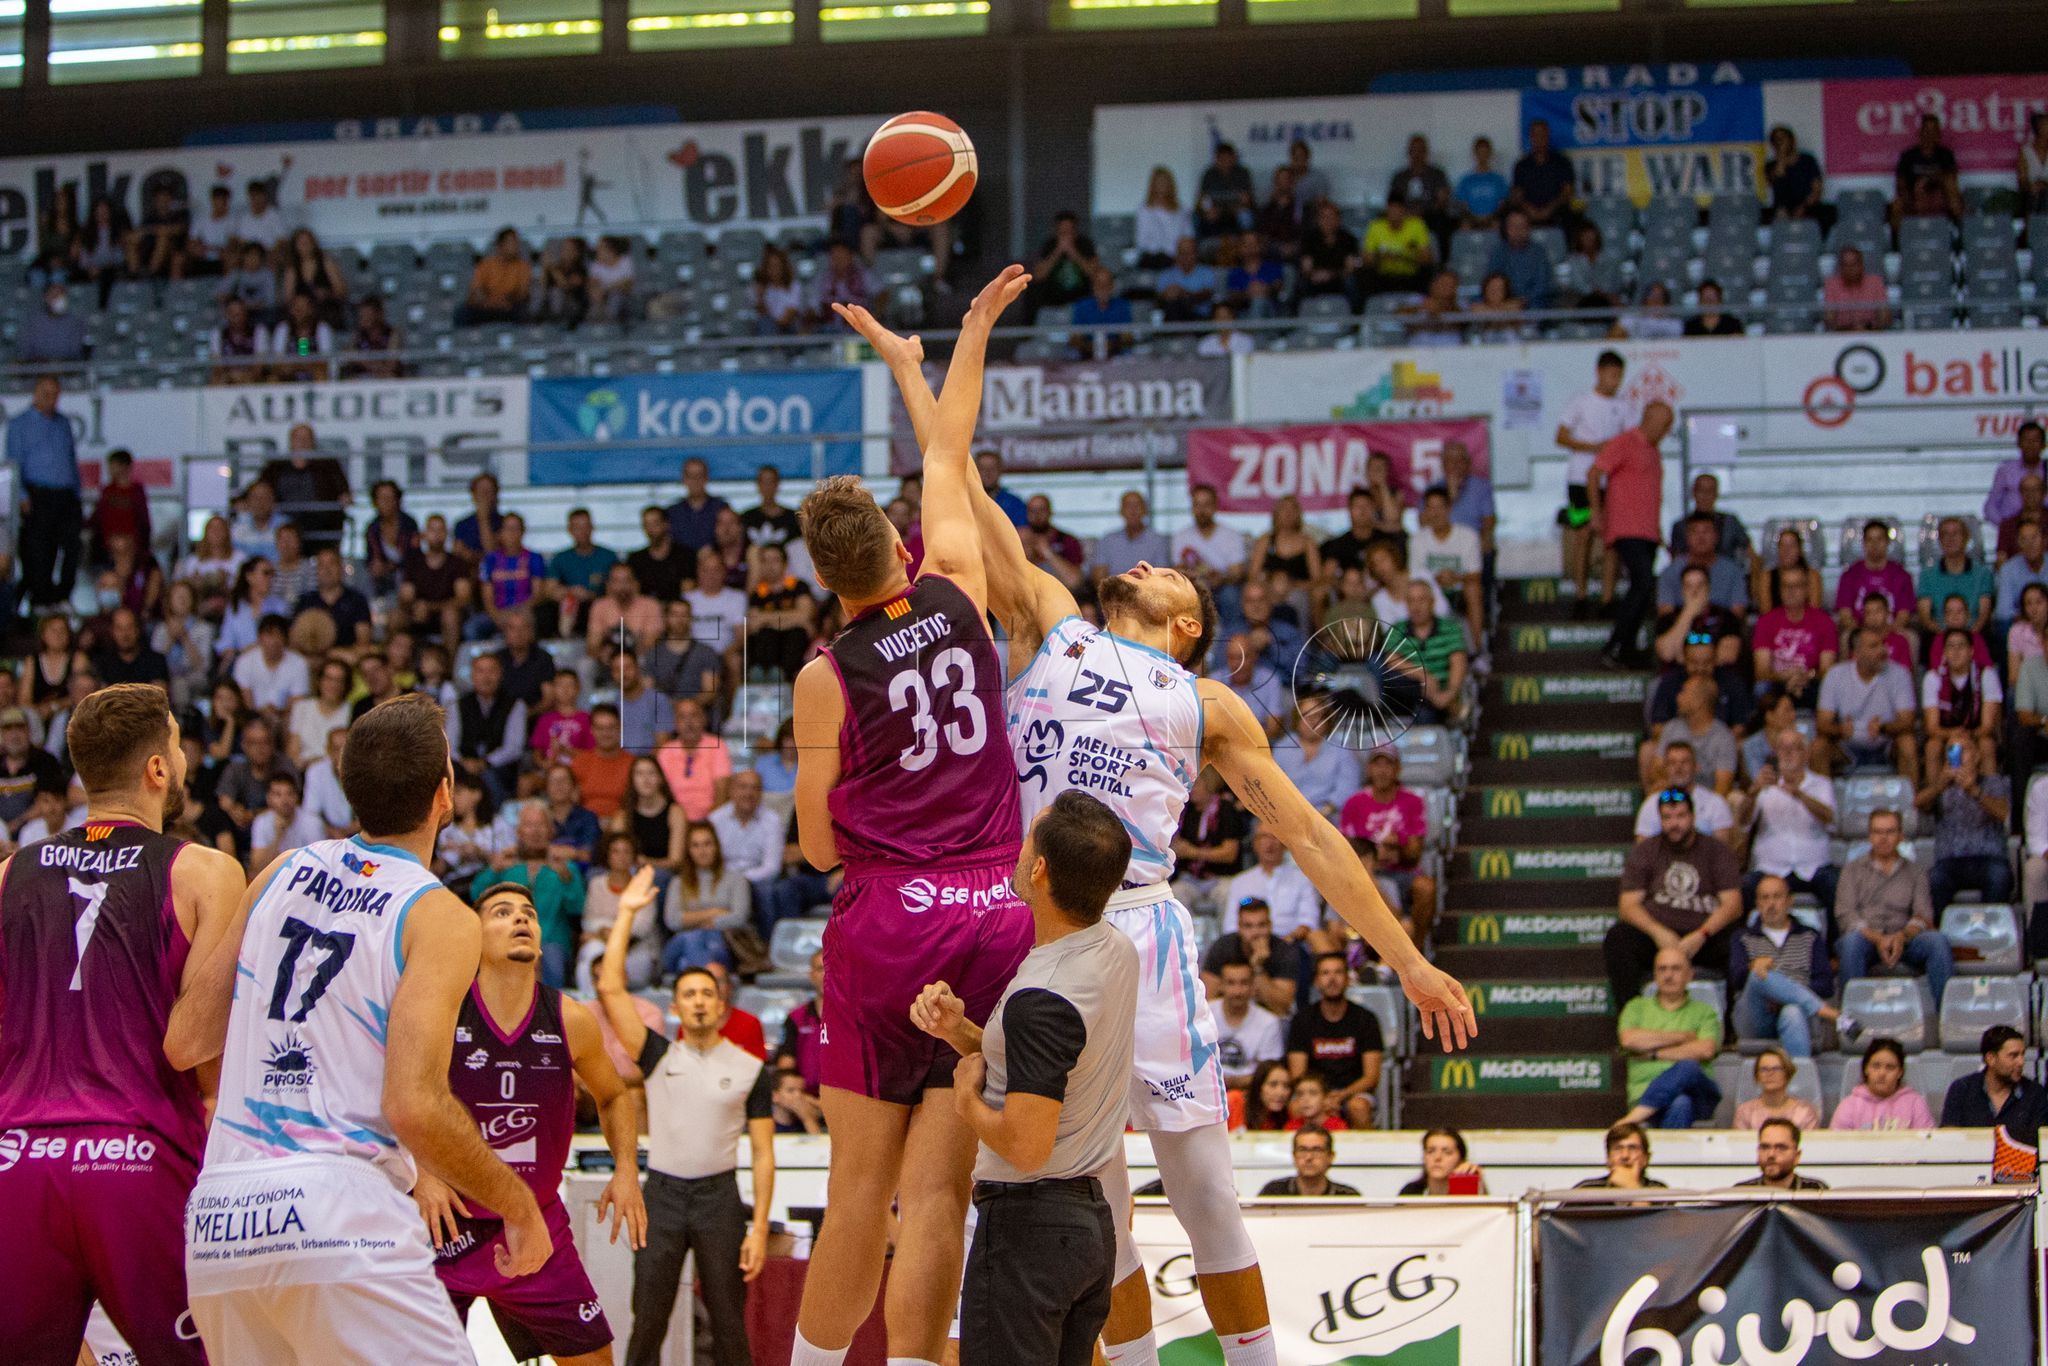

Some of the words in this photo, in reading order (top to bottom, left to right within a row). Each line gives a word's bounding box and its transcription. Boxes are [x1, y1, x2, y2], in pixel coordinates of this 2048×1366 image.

[1537, 61, 1743, 90] GRADA
[1571, 90, 1708, 145] STOP
[684, 127, 866, 224] ekk
[228, 388, 504, 425] Autocars
[638, 388, 812, 436] kroton
[987, 369, 1206, 427] Mañana
[1228, 436, 1371, 498] ZONA
[1410, 438, 1444, 493] 5
[873, 612, 952, 662] VUCETIC
[888, 646, 988, 772] 33
[1067, 669, 1133, 714] 25
[1069, 751, 1132, 778] SPORT
[1072, 735, 1148, 771] MELILLA
[1067, 769, 1134, 799] CAPITAL
[40, 844, 145, 873] GONZALEZ
[1513, 851, 1624, 869] McDonald's
[68, 877, 108, 991] 7
[267, 915, 357, 1023] 17
[1489, 986, 1608, 1004] McDonald's
[500, 1070, 515, 1100] 0
[1479, 1059, 1602, 1078] McDonald's
[480, 1108, 528, 1140] ICG
[72, 1163, 89, 1173] High
[91, 1162, 120, 1172] Quality
[121, 1162, 153, 1173] Logistics
[193, 1204, 306, 1244] MELILLA
[221, 1249, 232, 1260] de
[301, 1239, 350, 1250] Urbanismo
[360, 1238, 396, 1250] Deporte
[1318, 1253, 1436, 1333] ICG
